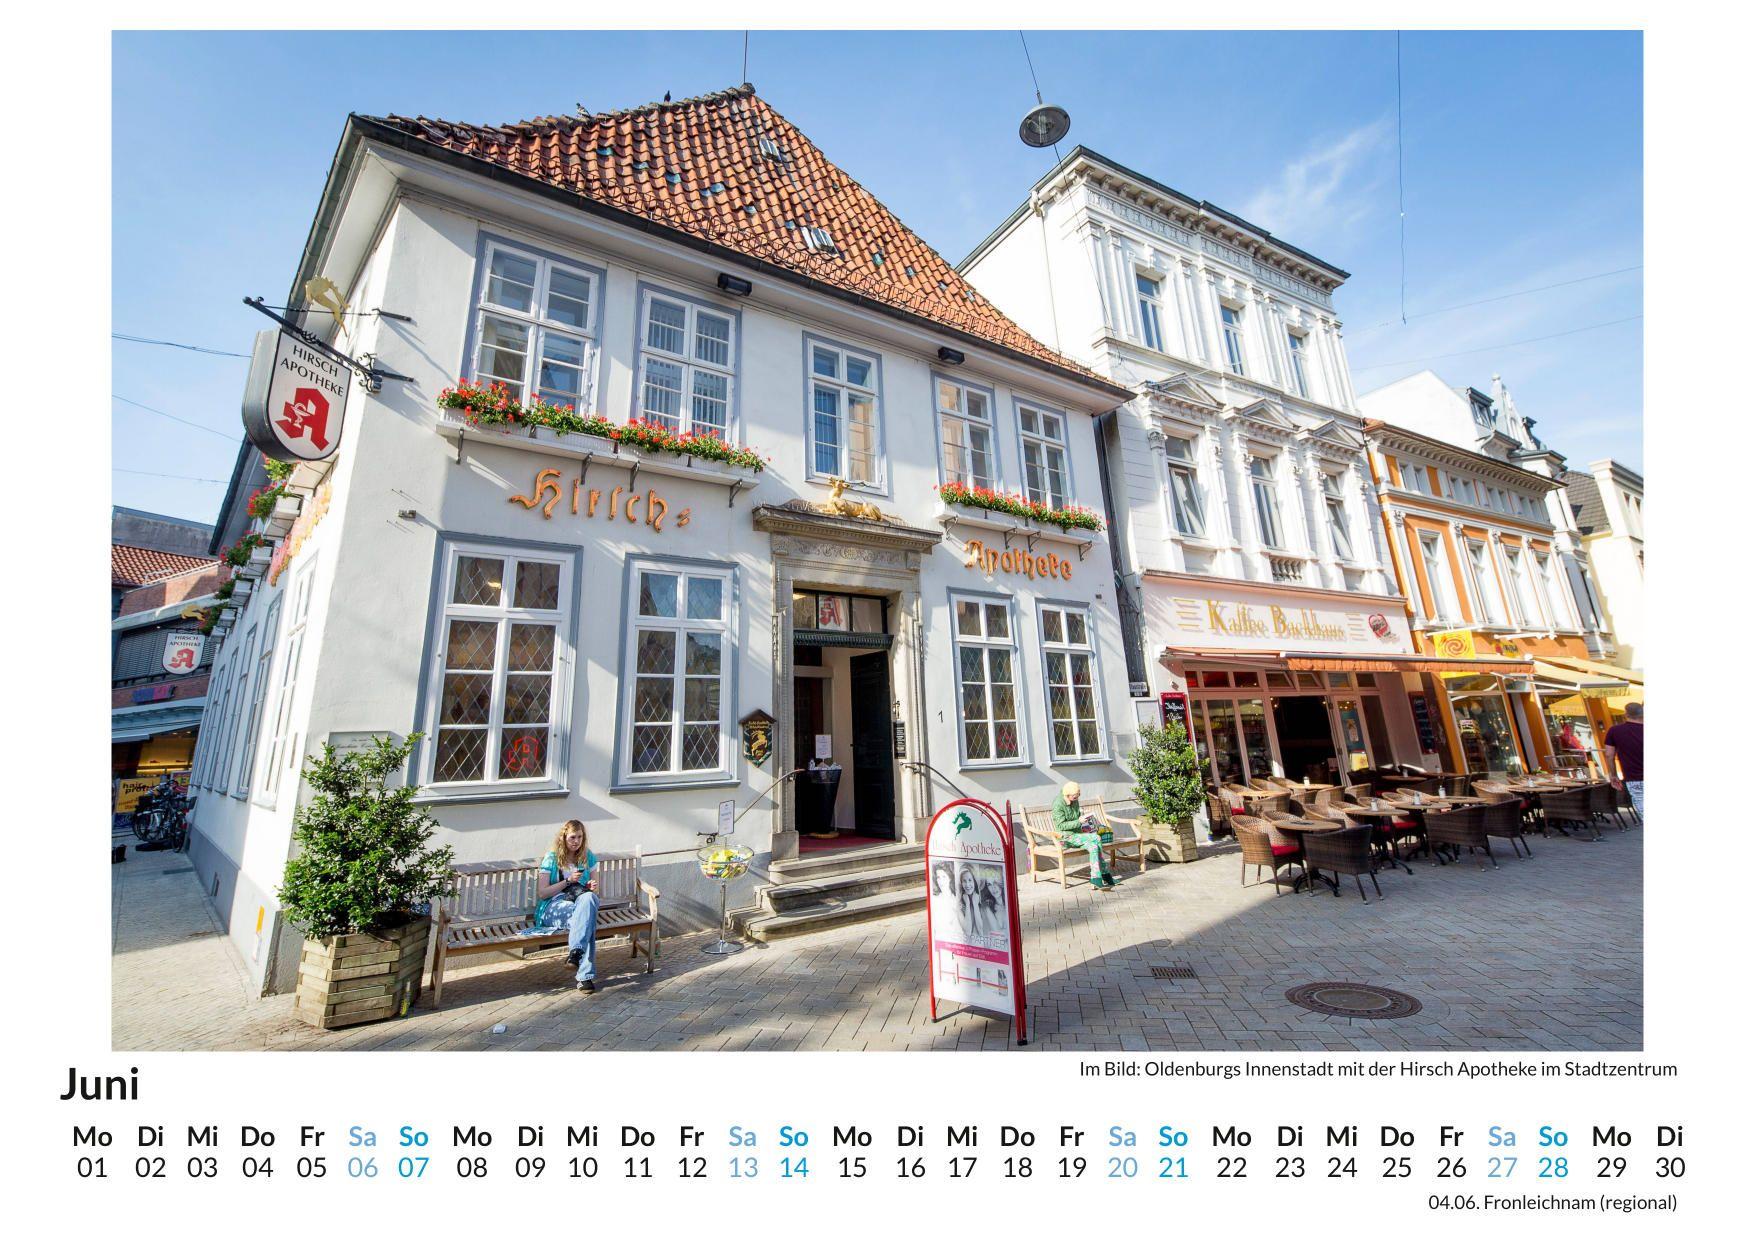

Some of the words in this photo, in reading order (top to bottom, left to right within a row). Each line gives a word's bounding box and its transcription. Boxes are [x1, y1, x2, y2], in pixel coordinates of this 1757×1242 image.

[280, 357, 344, 397] APOTHEKE
[293, 345, 338, 377] HIRSCH
[964, 539, 1073, 581] Apotheke
[1207, 599, 1267, 636] Kaffee
[938, 709, 944, 723] 1
[960, 841, 1001, 857] Apotheke
